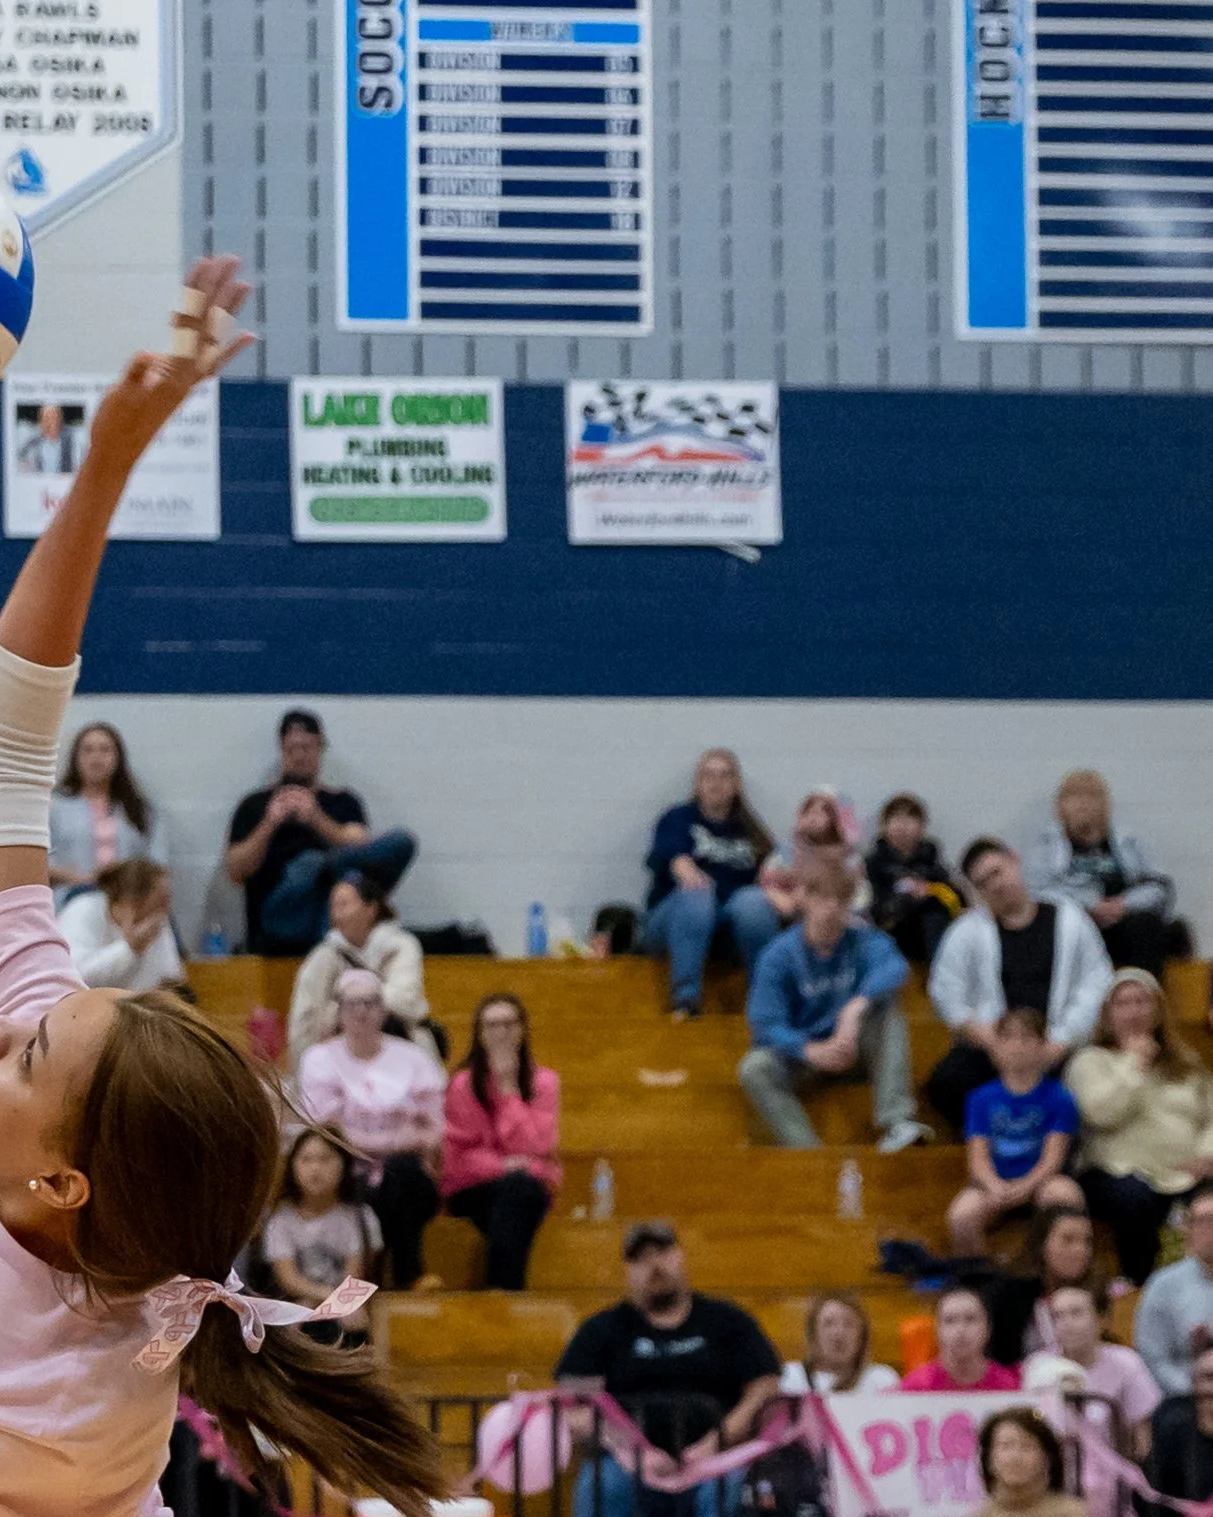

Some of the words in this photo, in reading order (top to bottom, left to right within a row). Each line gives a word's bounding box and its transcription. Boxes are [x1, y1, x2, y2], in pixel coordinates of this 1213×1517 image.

[16, 28, 139, 45] CHAPMAN
[358, 0, 394, 110] SOC
[3, 112, 77, 130] RELAY
[303, 394, 379, 425] LAKE
[303, 466, 379, 484] HEATING
[411, 467, 492, 484] COOLING
